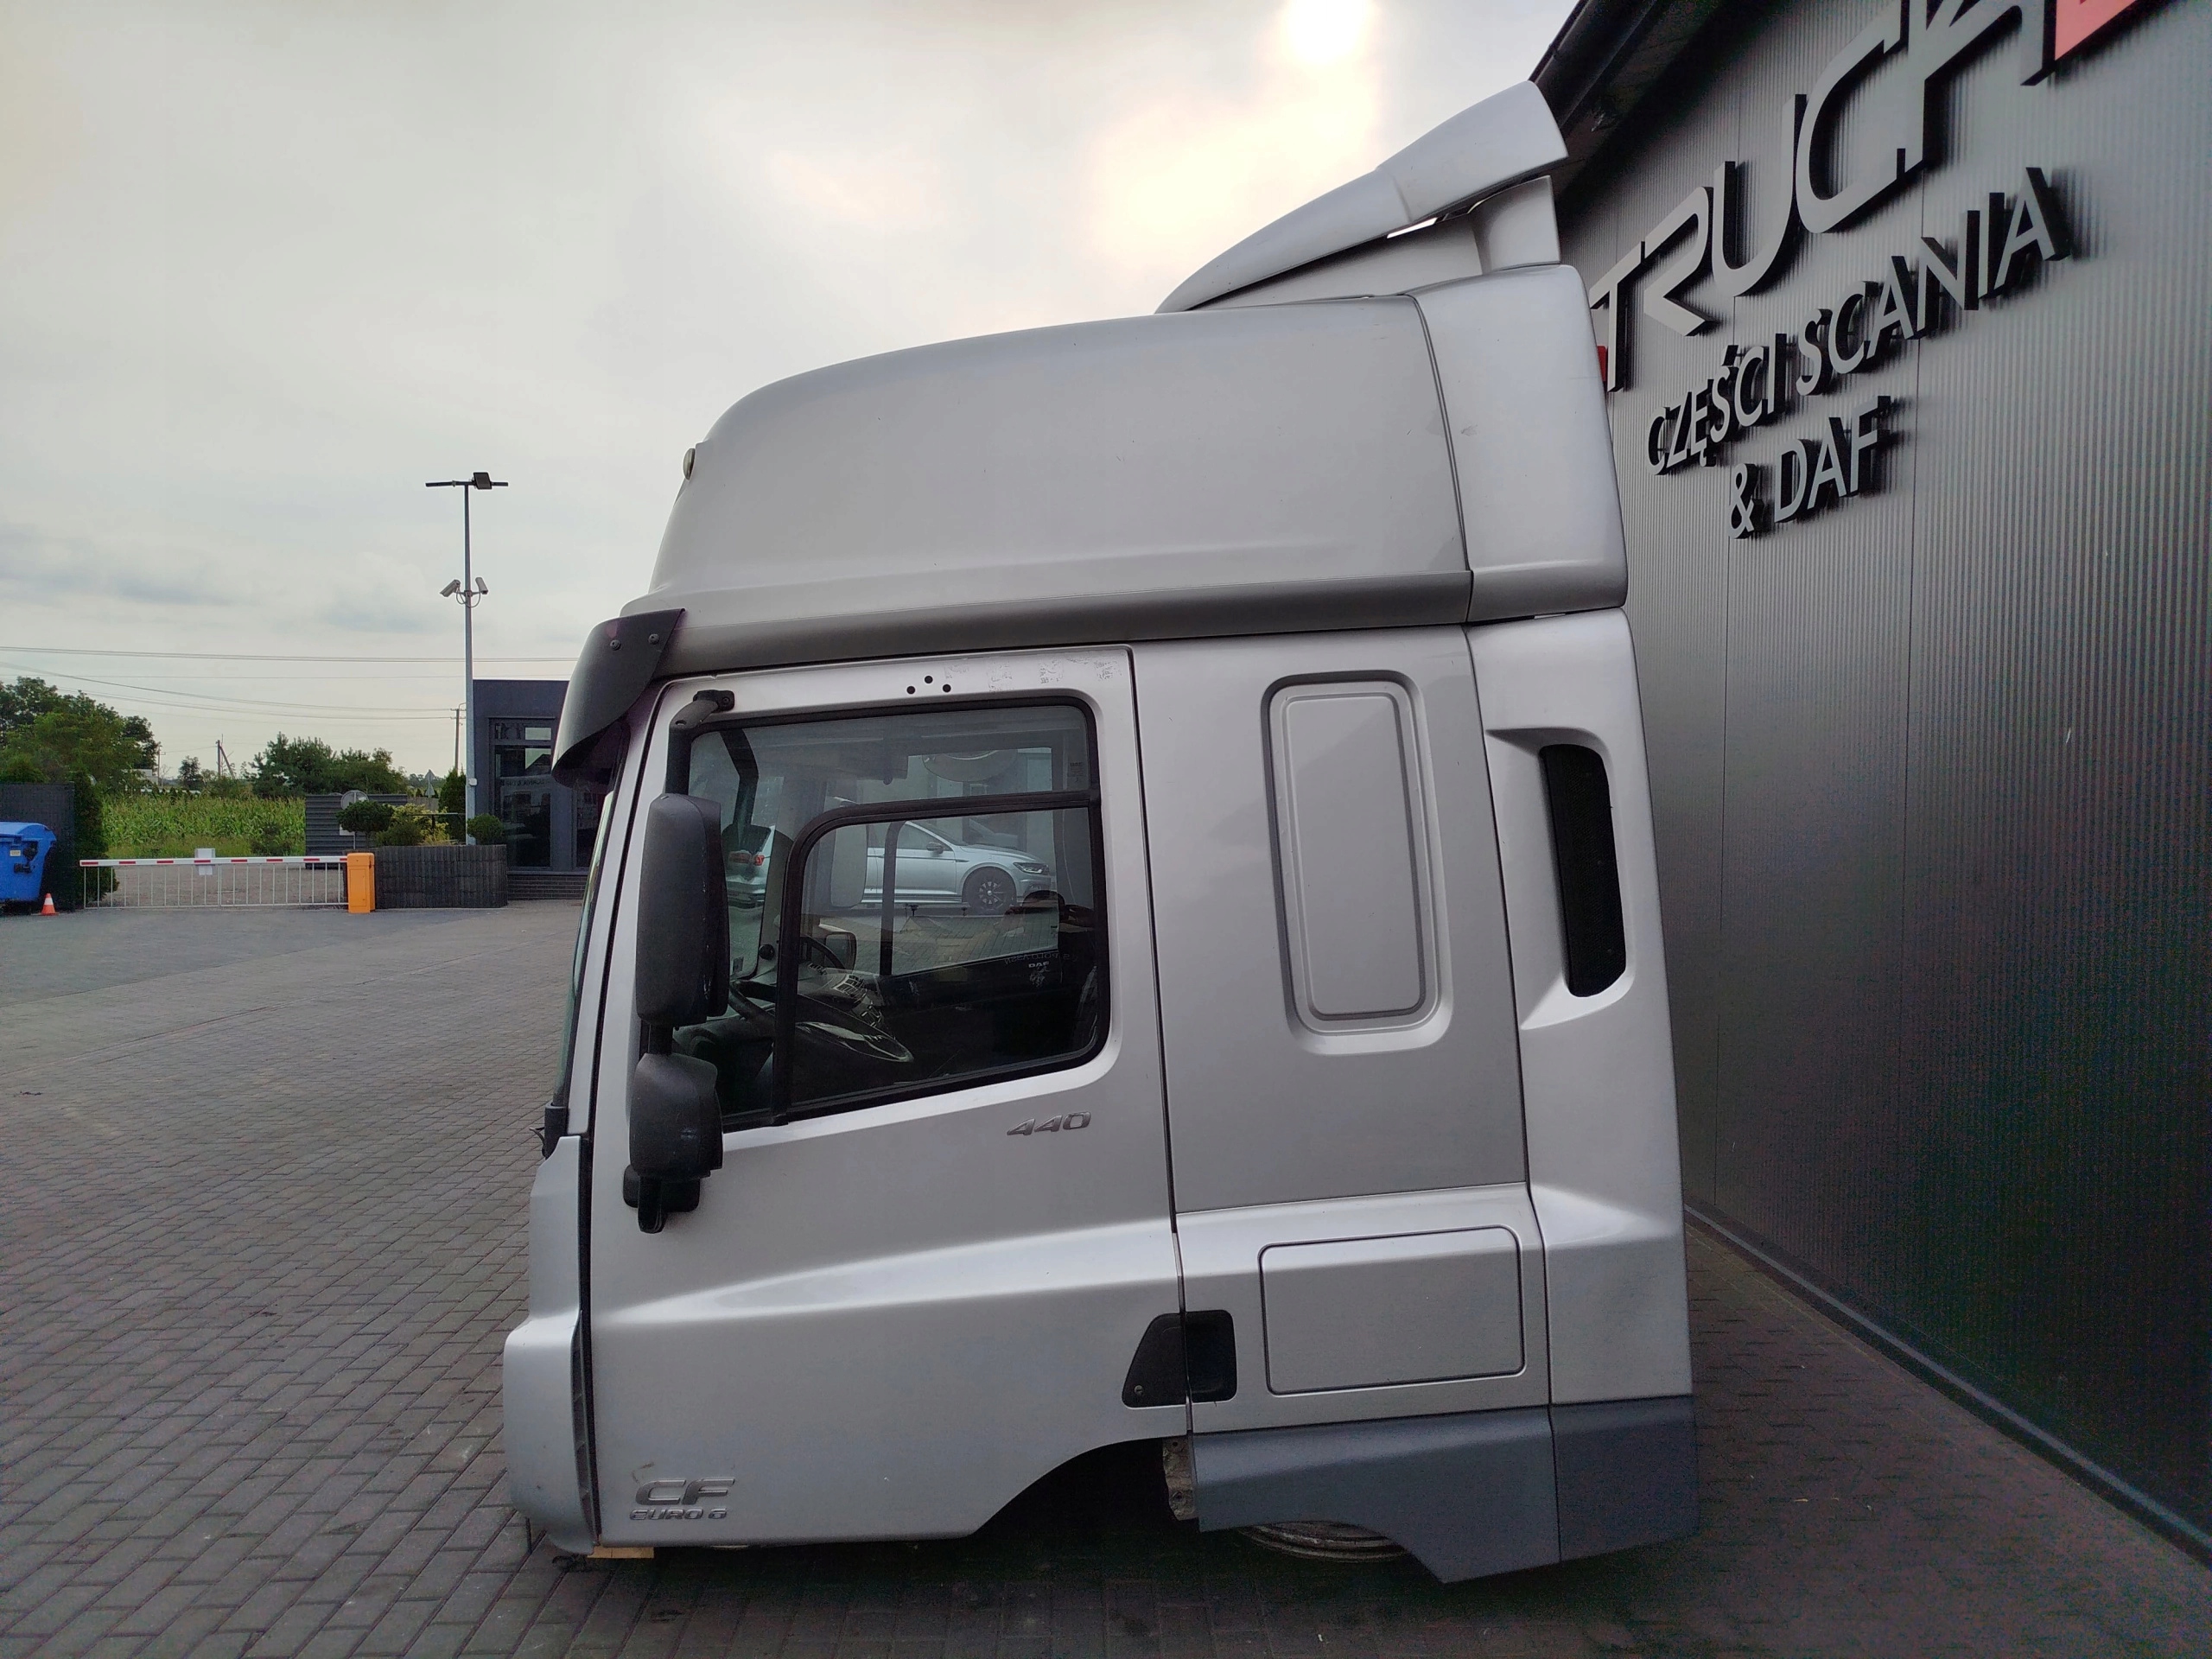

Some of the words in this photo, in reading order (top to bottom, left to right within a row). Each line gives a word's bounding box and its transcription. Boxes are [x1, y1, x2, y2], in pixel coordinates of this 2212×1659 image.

[1647, 334, 1787, 475] CZĘŚCI
[1796, 166, 2069, 397] SCANIA
[1729, 463, 1763, 539] &
[1773, 396, 1891, 524] DAF
[1007, 1111, 1091, 1136] 440
[635, 1477, 735, 1505] CF
[629, 1508, 704, 1521] EURO
[708, 1508, 728, 1520] 6
